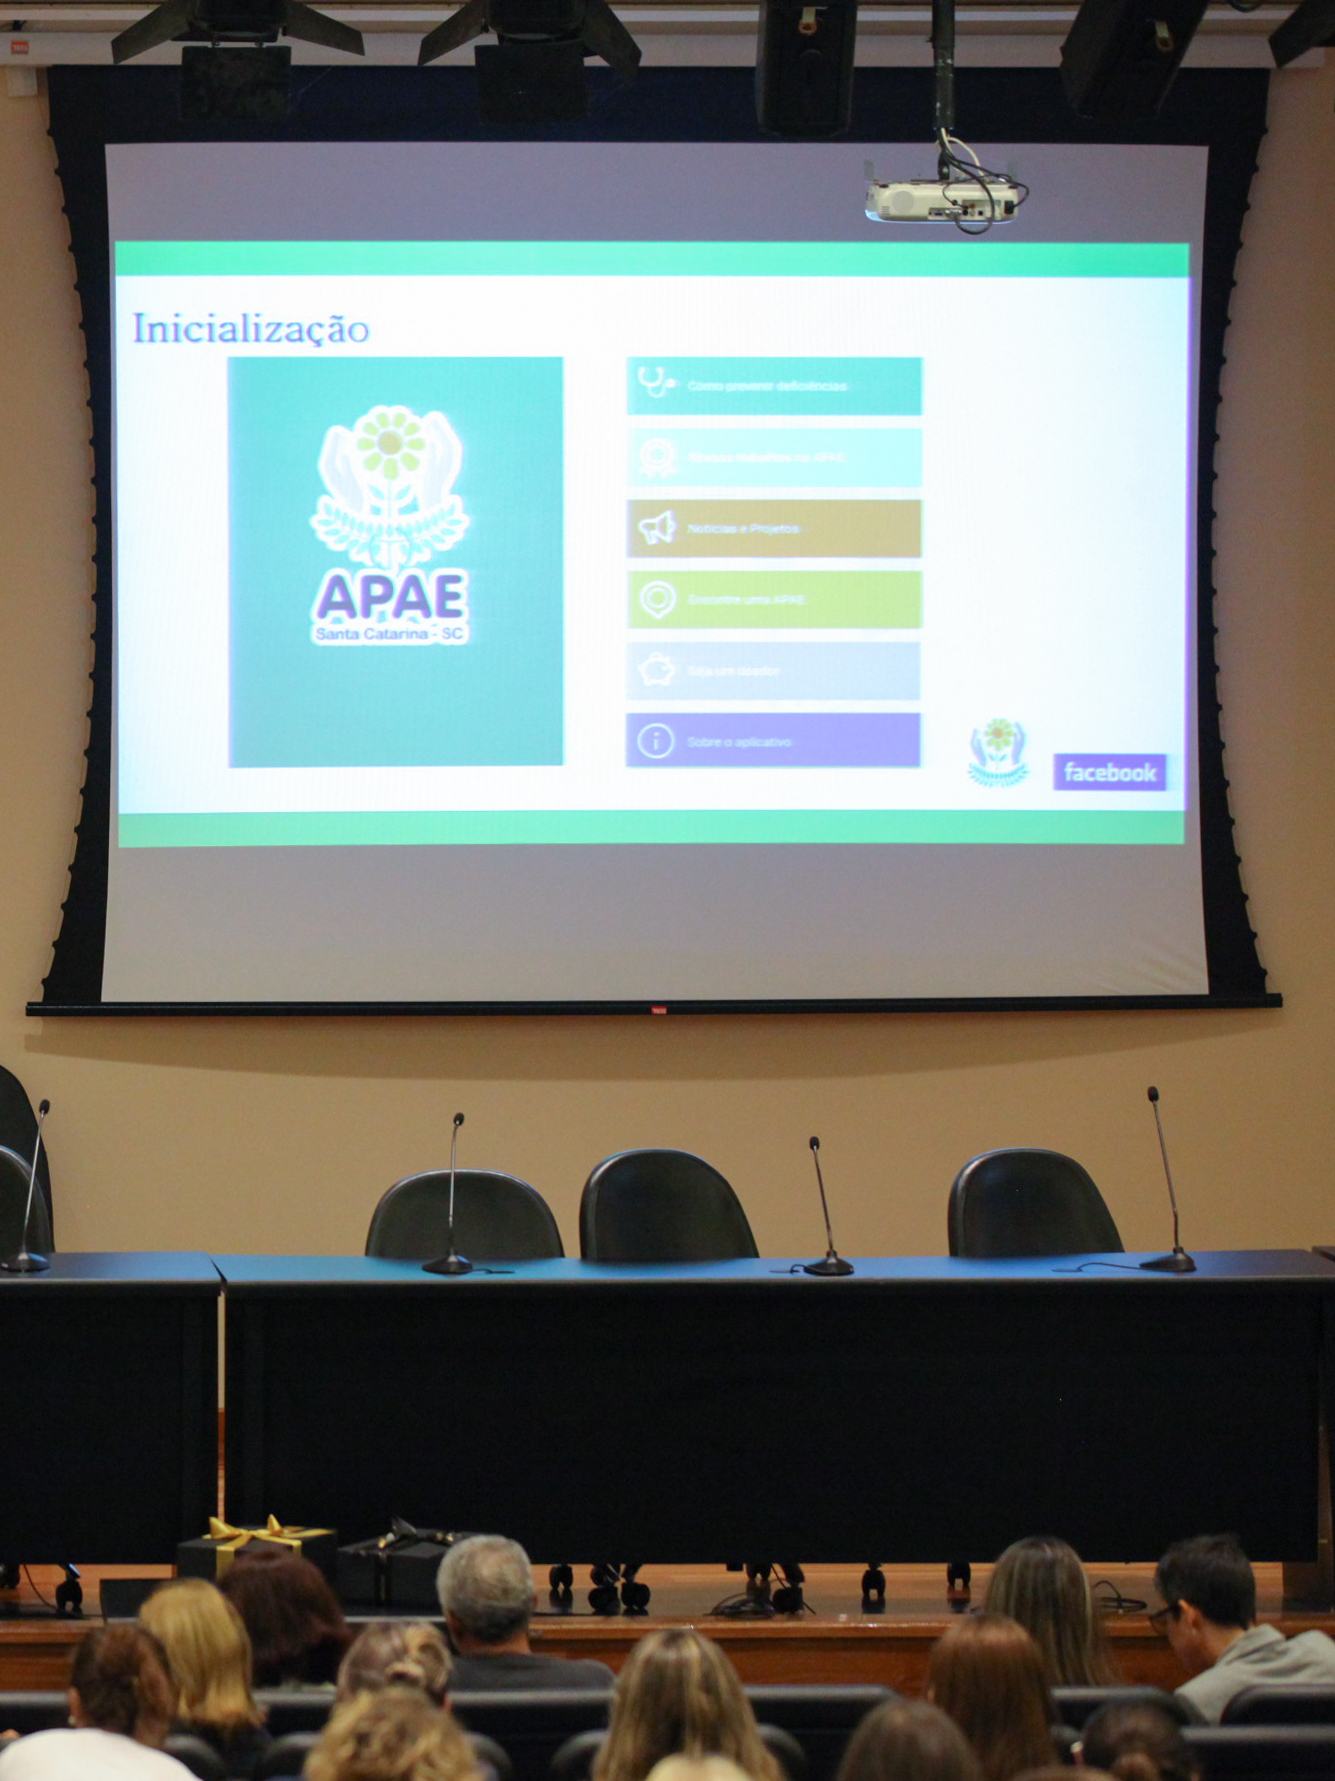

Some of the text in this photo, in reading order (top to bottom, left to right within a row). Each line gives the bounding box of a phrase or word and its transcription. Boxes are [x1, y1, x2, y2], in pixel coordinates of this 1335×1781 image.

[133, 312, 370, 348] Inicialização
[316, 573, 463, 620] APAE
[315, 627, 359, 640] Santa
[363, 627, 428, 640] Catarina
[441, 626, 464, 640] SC
[687, 736, 792, 749] Sobre o aplicativo
[1064, 761, 1158, 783] facebook
